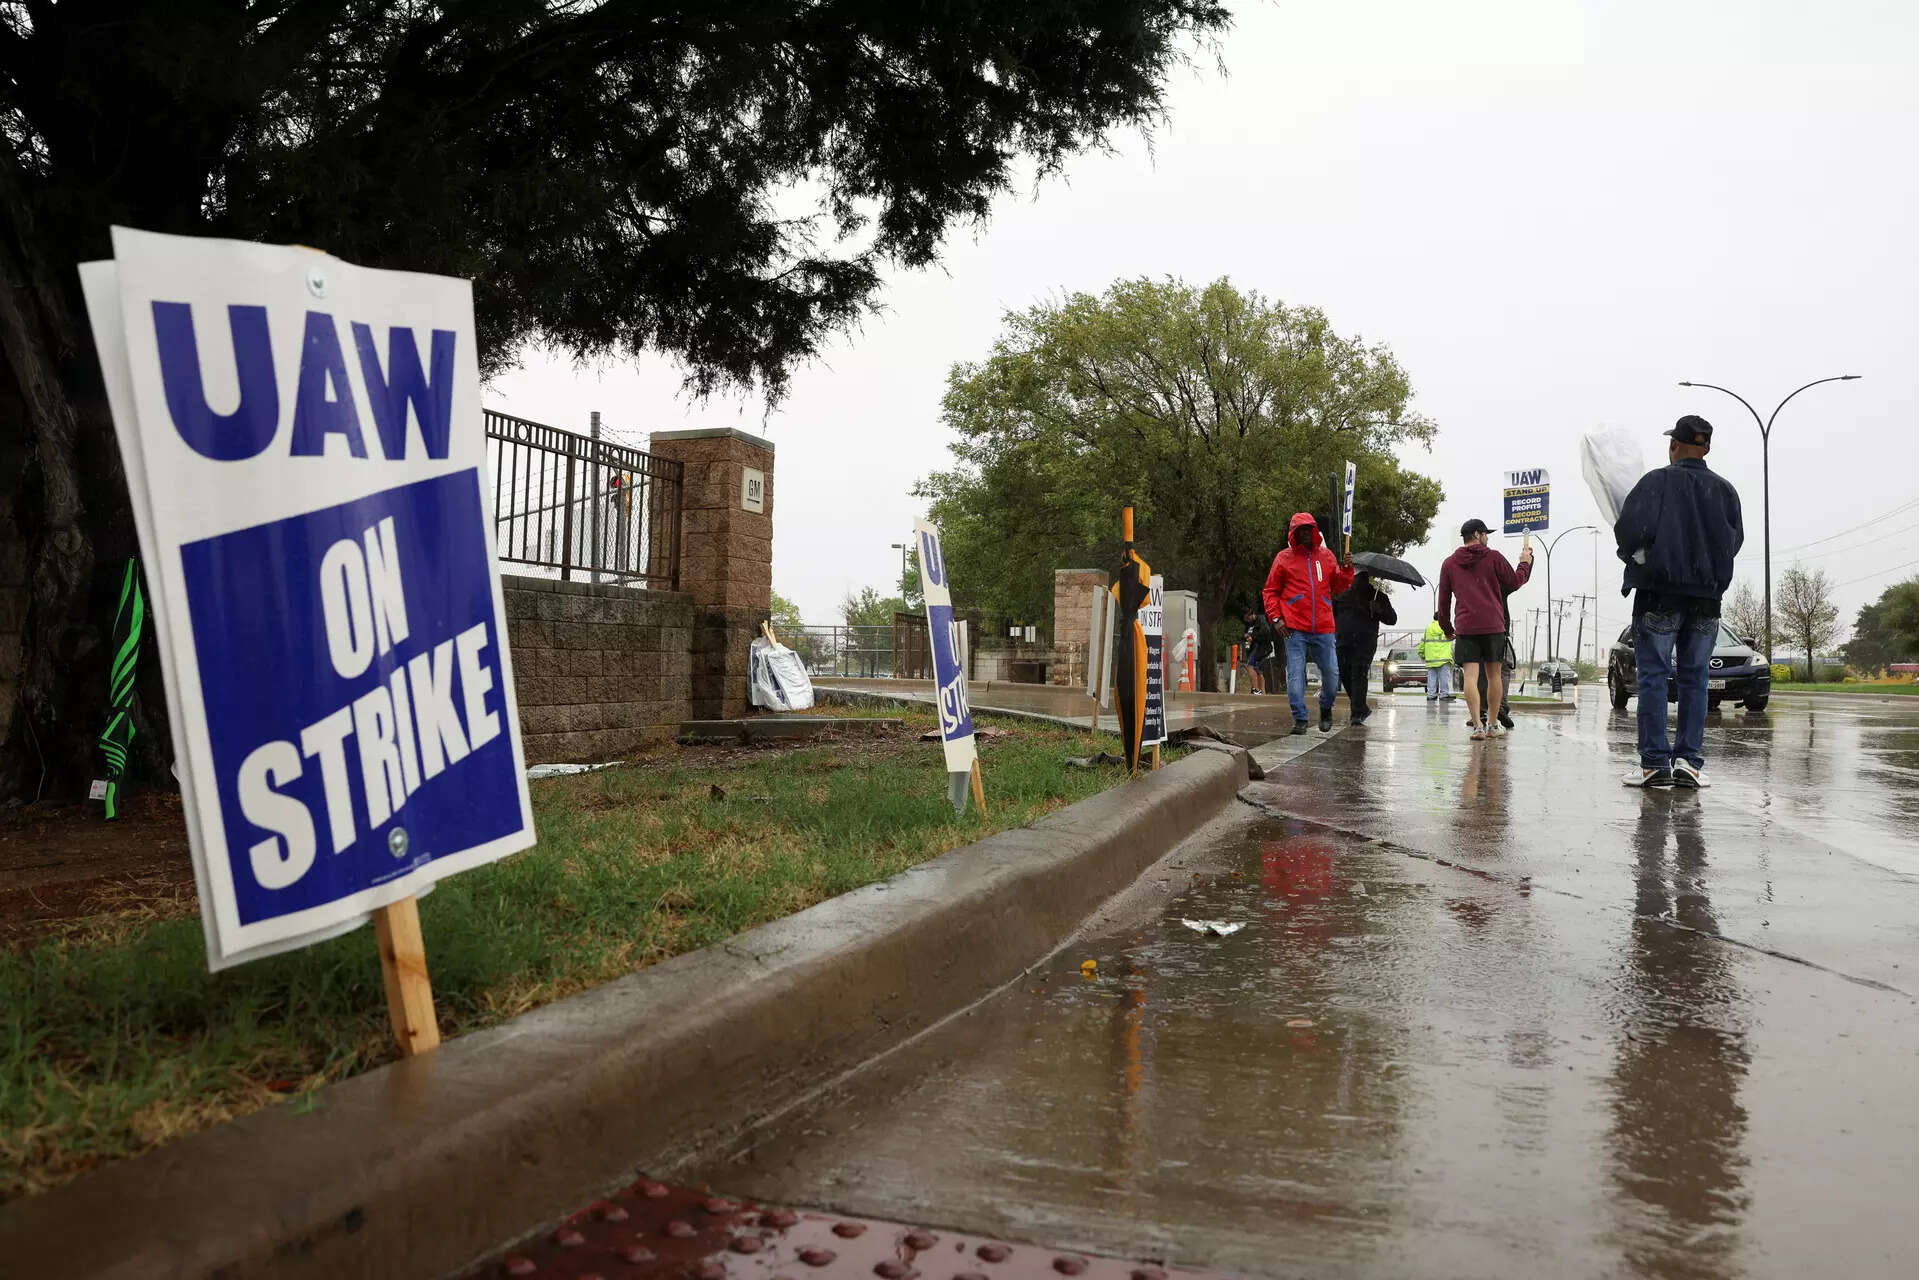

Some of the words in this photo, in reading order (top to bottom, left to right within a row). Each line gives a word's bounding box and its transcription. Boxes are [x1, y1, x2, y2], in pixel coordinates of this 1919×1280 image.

[152, 300, 456, 462] UAW
[1511, 469, 1541, 486] UAW
[748, 479, 761, 498] GM
[1506, 488, 1533, 496] STAND
[1535, 486, 1547, 494] UP
[1511, 497, 1542, 506] RECORD
[1511, 503, 1542, 512] PROFITS
[1505, 515, 1548, 525] CONTRACTS
[1511, 510, 1541, 518] RECORD
[320, 515, 408, 681] ON
[237, 621, 501, 890] STRIKE
